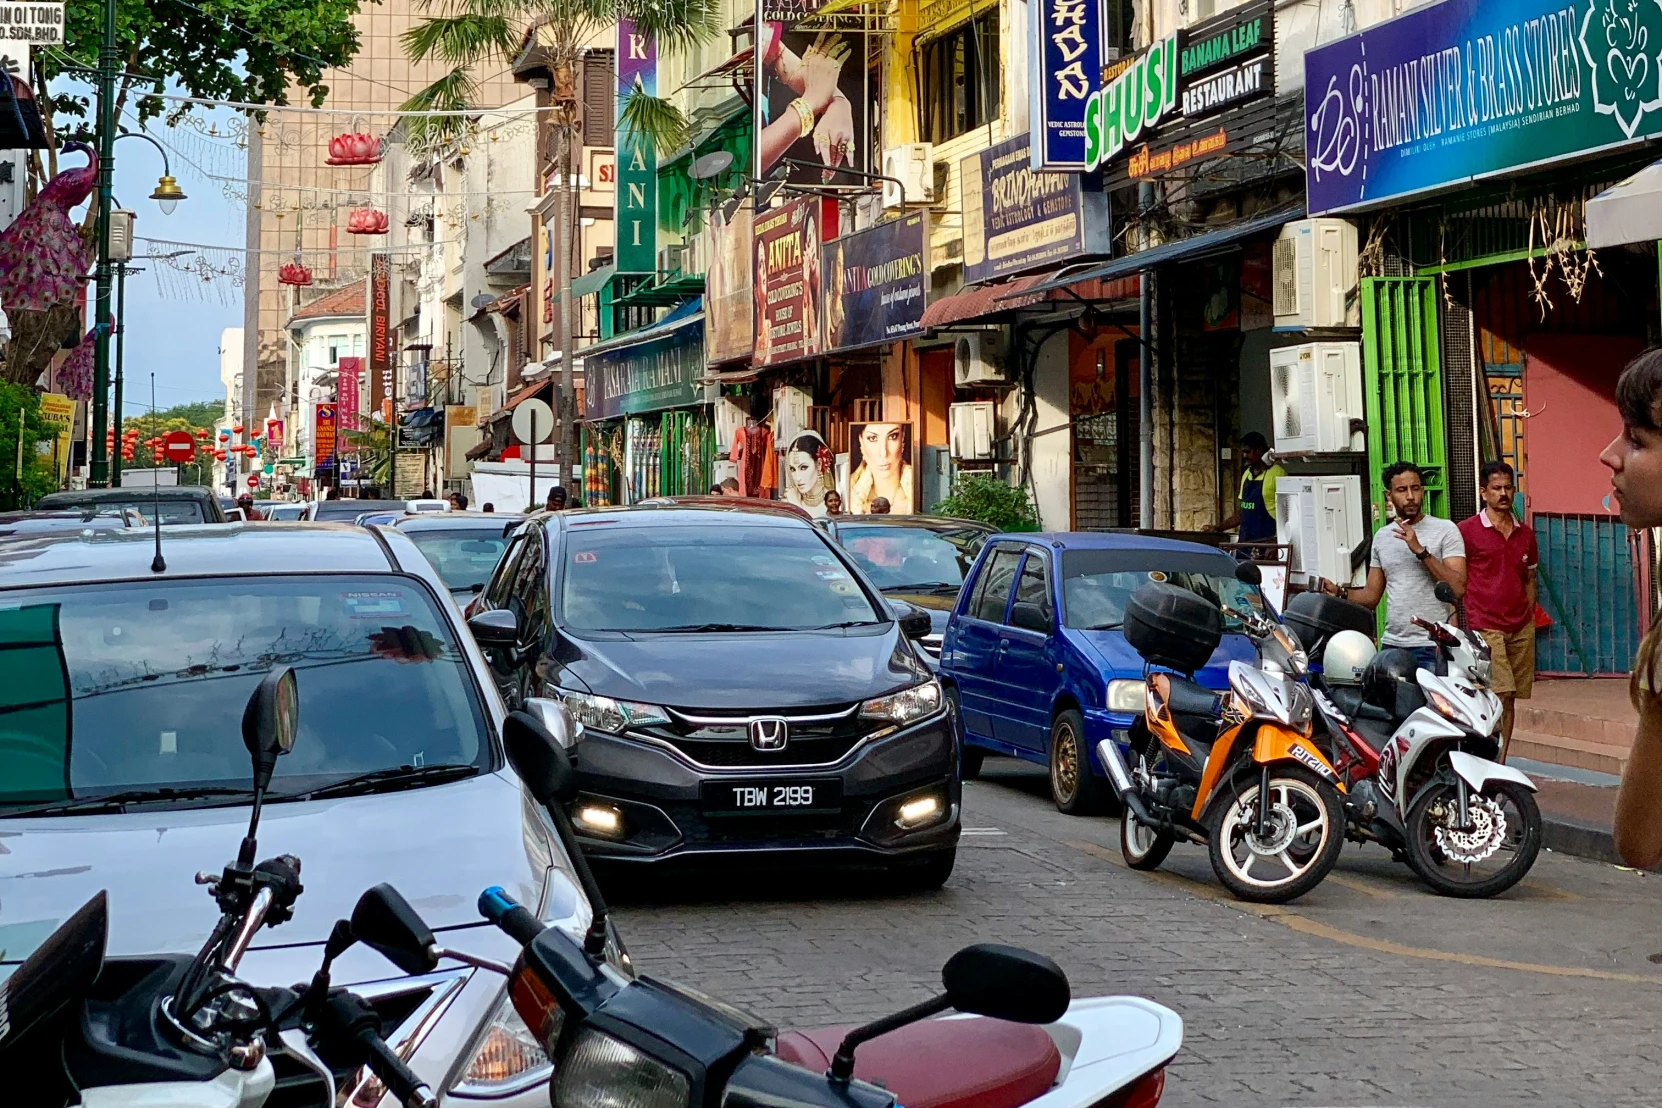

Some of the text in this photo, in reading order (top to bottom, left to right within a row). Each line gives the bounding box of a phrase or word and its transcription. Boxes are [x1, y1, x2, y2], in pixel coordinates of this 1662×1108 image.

[14, 6, 27, 24] OI
[29, 7, 62, 24] TONG
[764, 11, 796, 21] GOLD
[1181, 19, 1261, 76] BANANA LEAF
[1182, 63, 1261, 116] RESTAURANT
[1371, 5, 1581, 152] RAMANI SILVER & BRASS STORES
[1085, 30, 1177, 172] SHUSI
[628, 33, 647, 246] RAANI
[1441, 132, 1465, 147] RAMANIE
[1466, 127, 1487, 142] STORES
[1521, 109, 1554, 126] SENDIRIAN
[1555, 103, 1580, 118] BERHAD
[1043, 195, 1072, 215] GEMSTONE
[768, 230, 802, 275] ANITA
[868, 265, 884, 288] GOLD
[375, 315, 386, 362] BIRIYANI
[643, 347, 682, 390] RAMANI
[1291, 745, 1333, 777] PJT2110
[732, 785, 813, 807] TBW 2199
